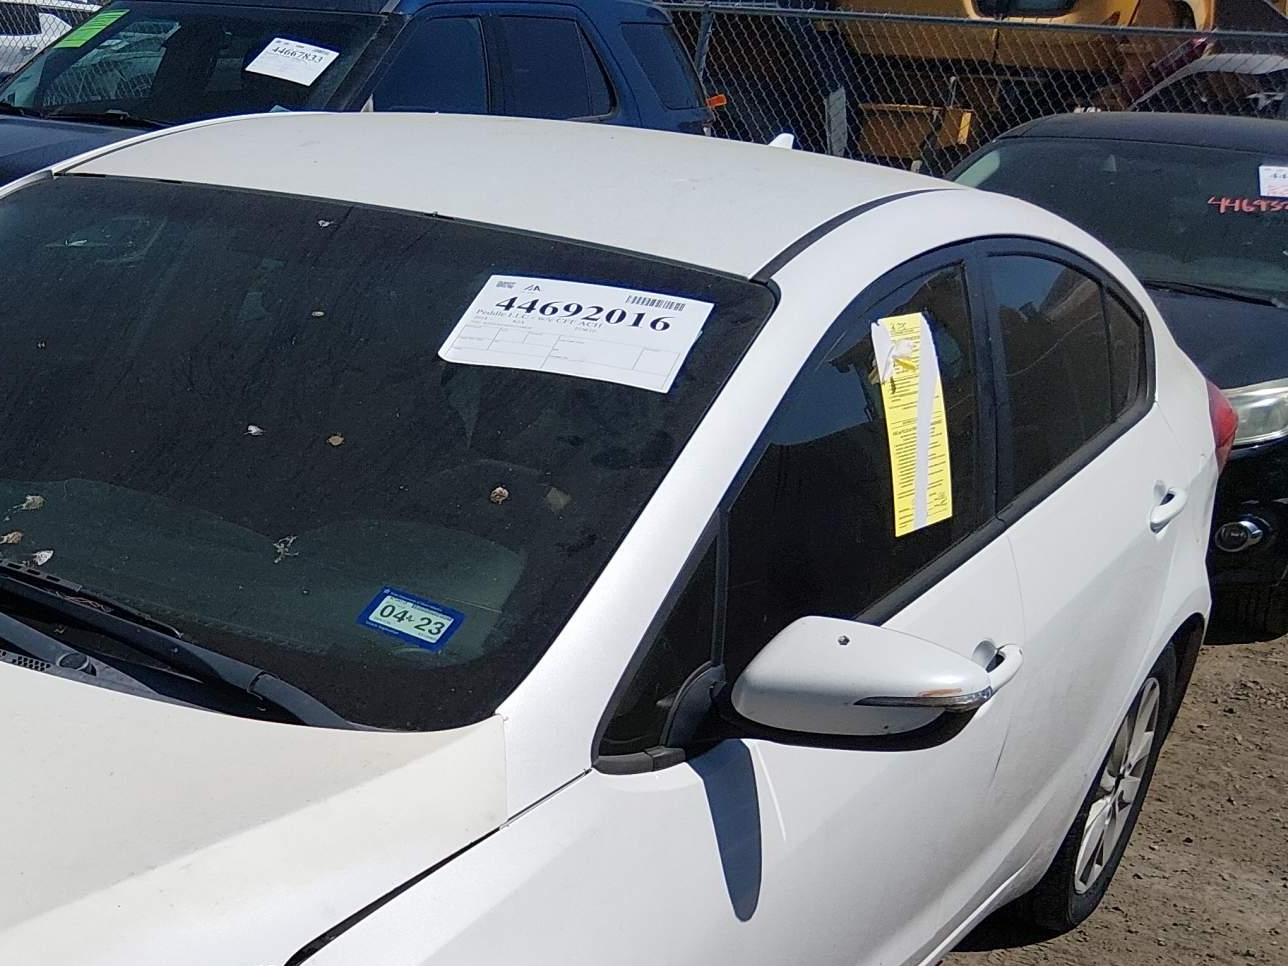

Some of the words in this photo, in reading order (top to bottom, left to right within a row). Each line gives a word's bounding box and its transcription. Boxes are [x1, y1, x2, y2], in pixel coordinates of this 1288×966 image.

[272, 46, 324, 63] 44667833
[495, 296, 675, 332] 44692016
[380, 604, 409, 623] 04
[414, 616, 445, 636] 23
